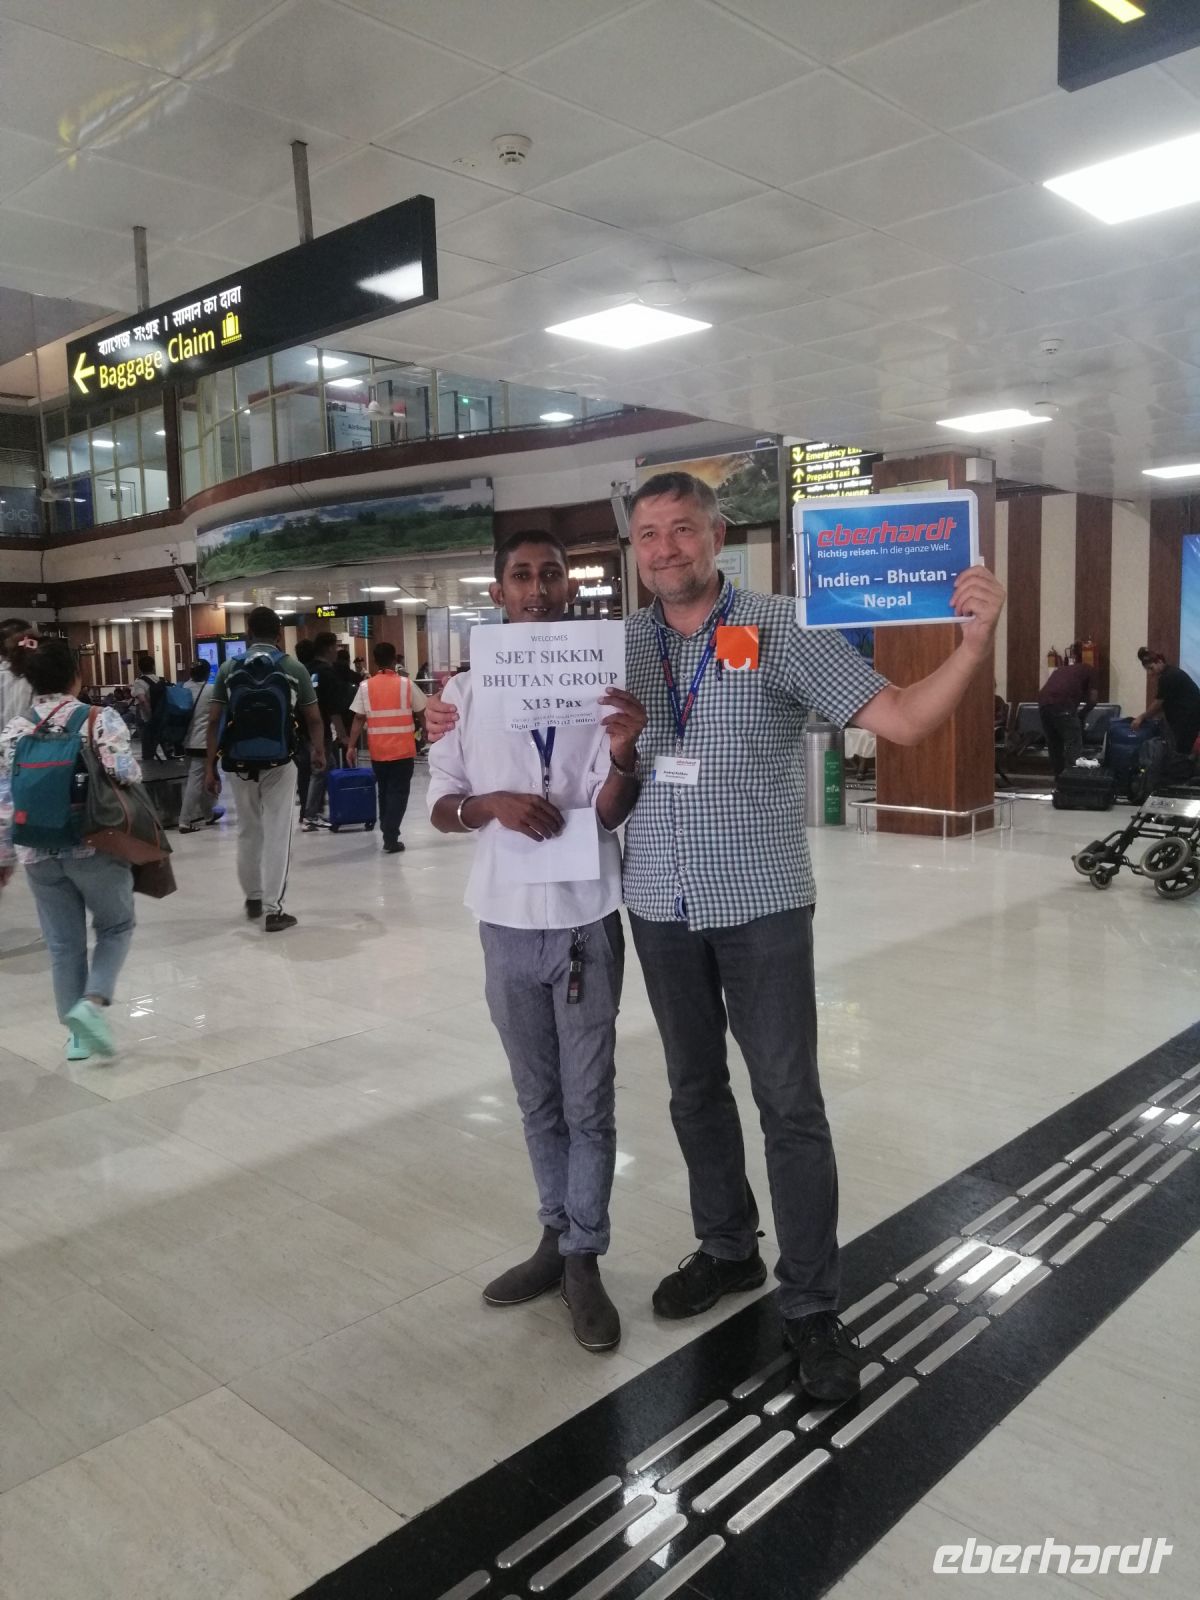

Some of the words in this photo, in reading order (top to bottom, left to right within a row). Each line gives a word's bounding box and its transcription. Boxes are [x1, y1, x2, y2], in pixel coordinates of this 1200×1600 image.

[172, 301, 202, 328] सामान
[203, 296, 218, 315] का
[219, 286, 242, 310] दावा
[99, 350, 163, 390] Baggage
[168, 328, 216, 363] Claim
[806, 448, 846, 461] Emergency
[806, 470, 833, 482] Prepaid
[835, 469, 850, 478] Taxi
[816, 517, 957, 548] eberhardt
[817, 548, 848, 559] Richtig
[849, 547, 879, 556] reisen.
[880, 546, 889, 554] In
[890, 545, 903, 554] die
[904, 545, 929, 555] ganze
[930, 542, 952, 552] Welt.
[817, 572, 870, 588] Indien
[887, 569, 947, 584] Bhutan
[863, 591, 912, 609] Nepal
[530, 634, 568, 642] WELCOMES
[495, 650, 536, 665] SJET
[540, 649, 604, 664] SIKKIM
[482, 674, 554, 688] BHUTAN
[558, 672, 618, 686] GROUP
[522, 698, 551, 711] X13
[555, 698, 582, 709] Pax
